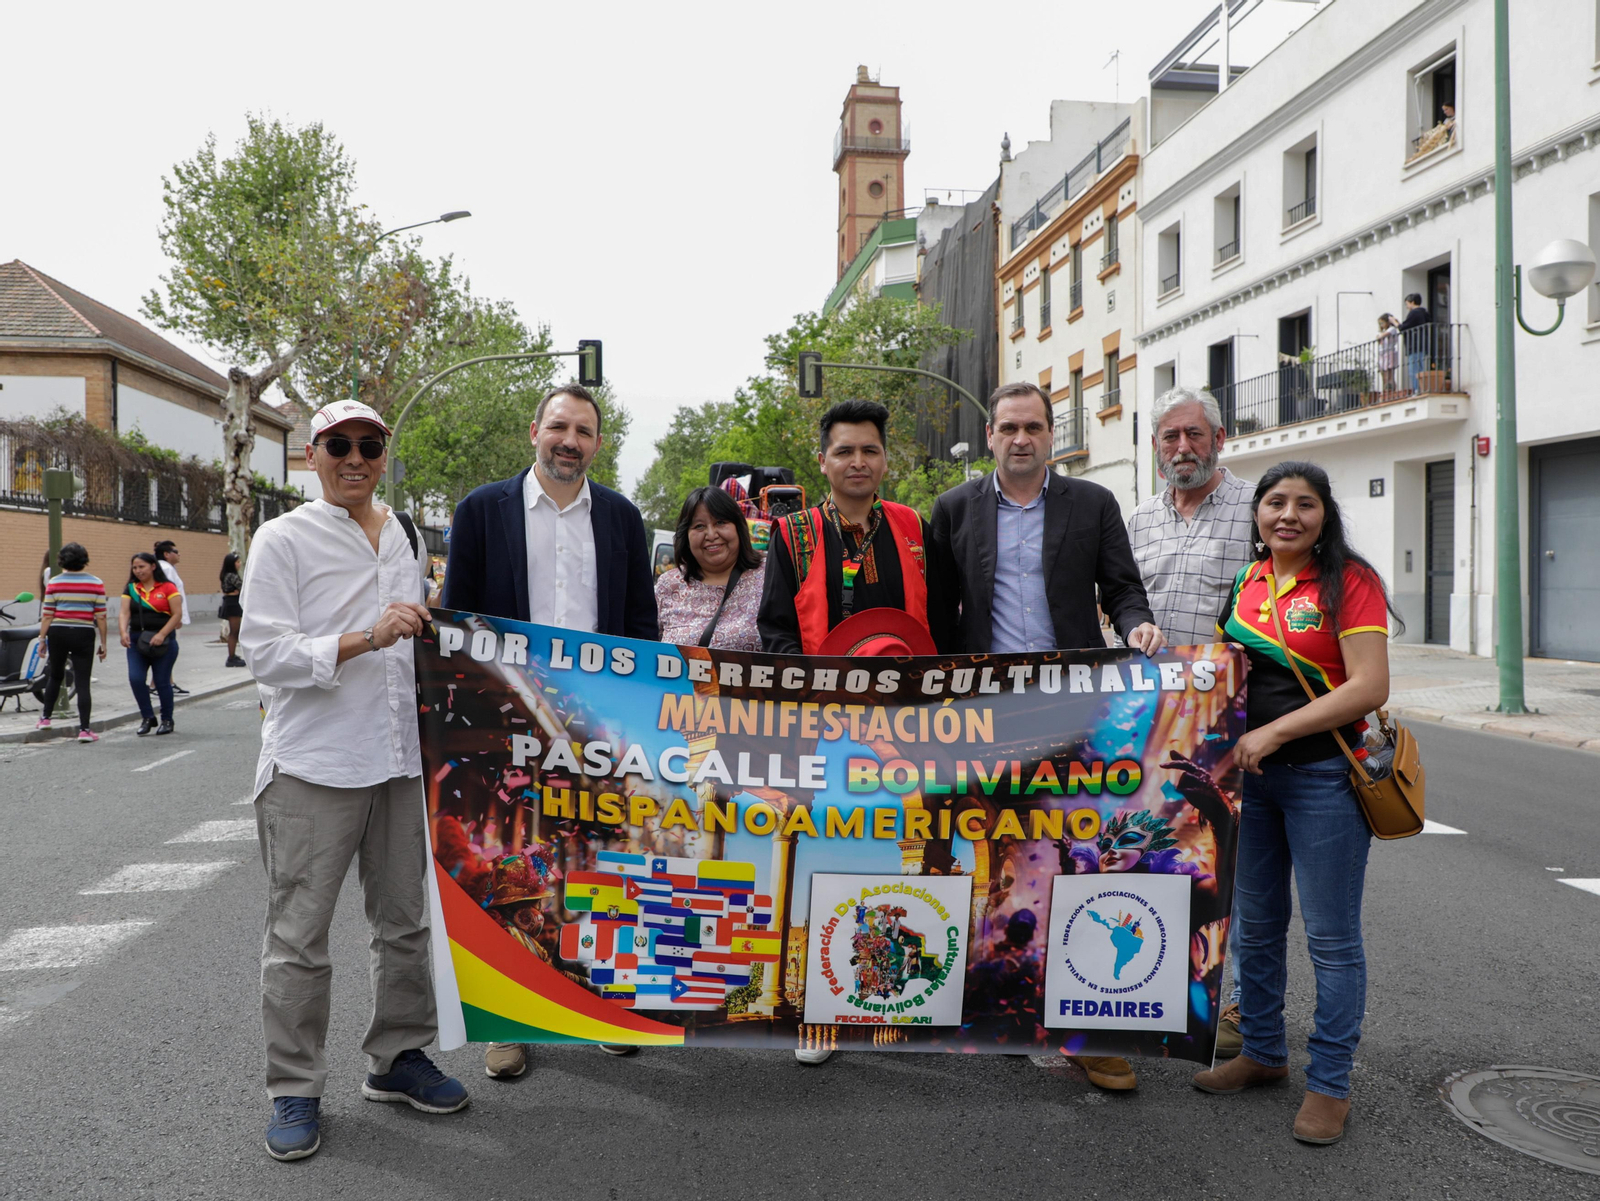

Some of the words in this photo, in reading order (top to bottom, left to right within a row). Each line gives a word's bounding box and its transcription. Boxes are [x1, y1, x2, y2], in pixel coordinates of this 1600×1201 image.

[438, 626, 528, 665] POR
[550, 638, 636, 675] LOS
[656, 653, 901, 692] DERECHOS
[920, 660, 1217, 695] CULTURALES
[657, 692, 995, 744] MANIFESTACIÓN
[511, 733, 828, 790] PASACALLE
[847, 757, 1142, 796] BOLIVIANO
[541, 785, 1101, 842] HISPANOAMERICANO
[833, 897, 858, 917] De
[860, 881, 951, 922] Asociaciones
[1085, 896, 1096, 905] DE
[1097, 890, 1149, 907] ASOCIACIONES
[1148, 906, 1158, 917] DE
[1062, 903, 1086, 946] FEDERACIÓN
[819, 916, 845, 997] Federación
[924, 925, 960, 997] Culturales
[1143, 916, 1167, 985] IBEROAMERICANOS
[1064, 957, 1087, 984] SEVILLA
[1087, 981, 1098, 991] EN
[1099, 981, 1144, 995] RESIDENTES
[846, 993, 926, 1015] Bolivianas
[1059, 998, 1164, 1019] FEDAIRES
[835, 1014, 888, 1024] FECUBOL
[891, 1015, 933, 1025] SAYARI
